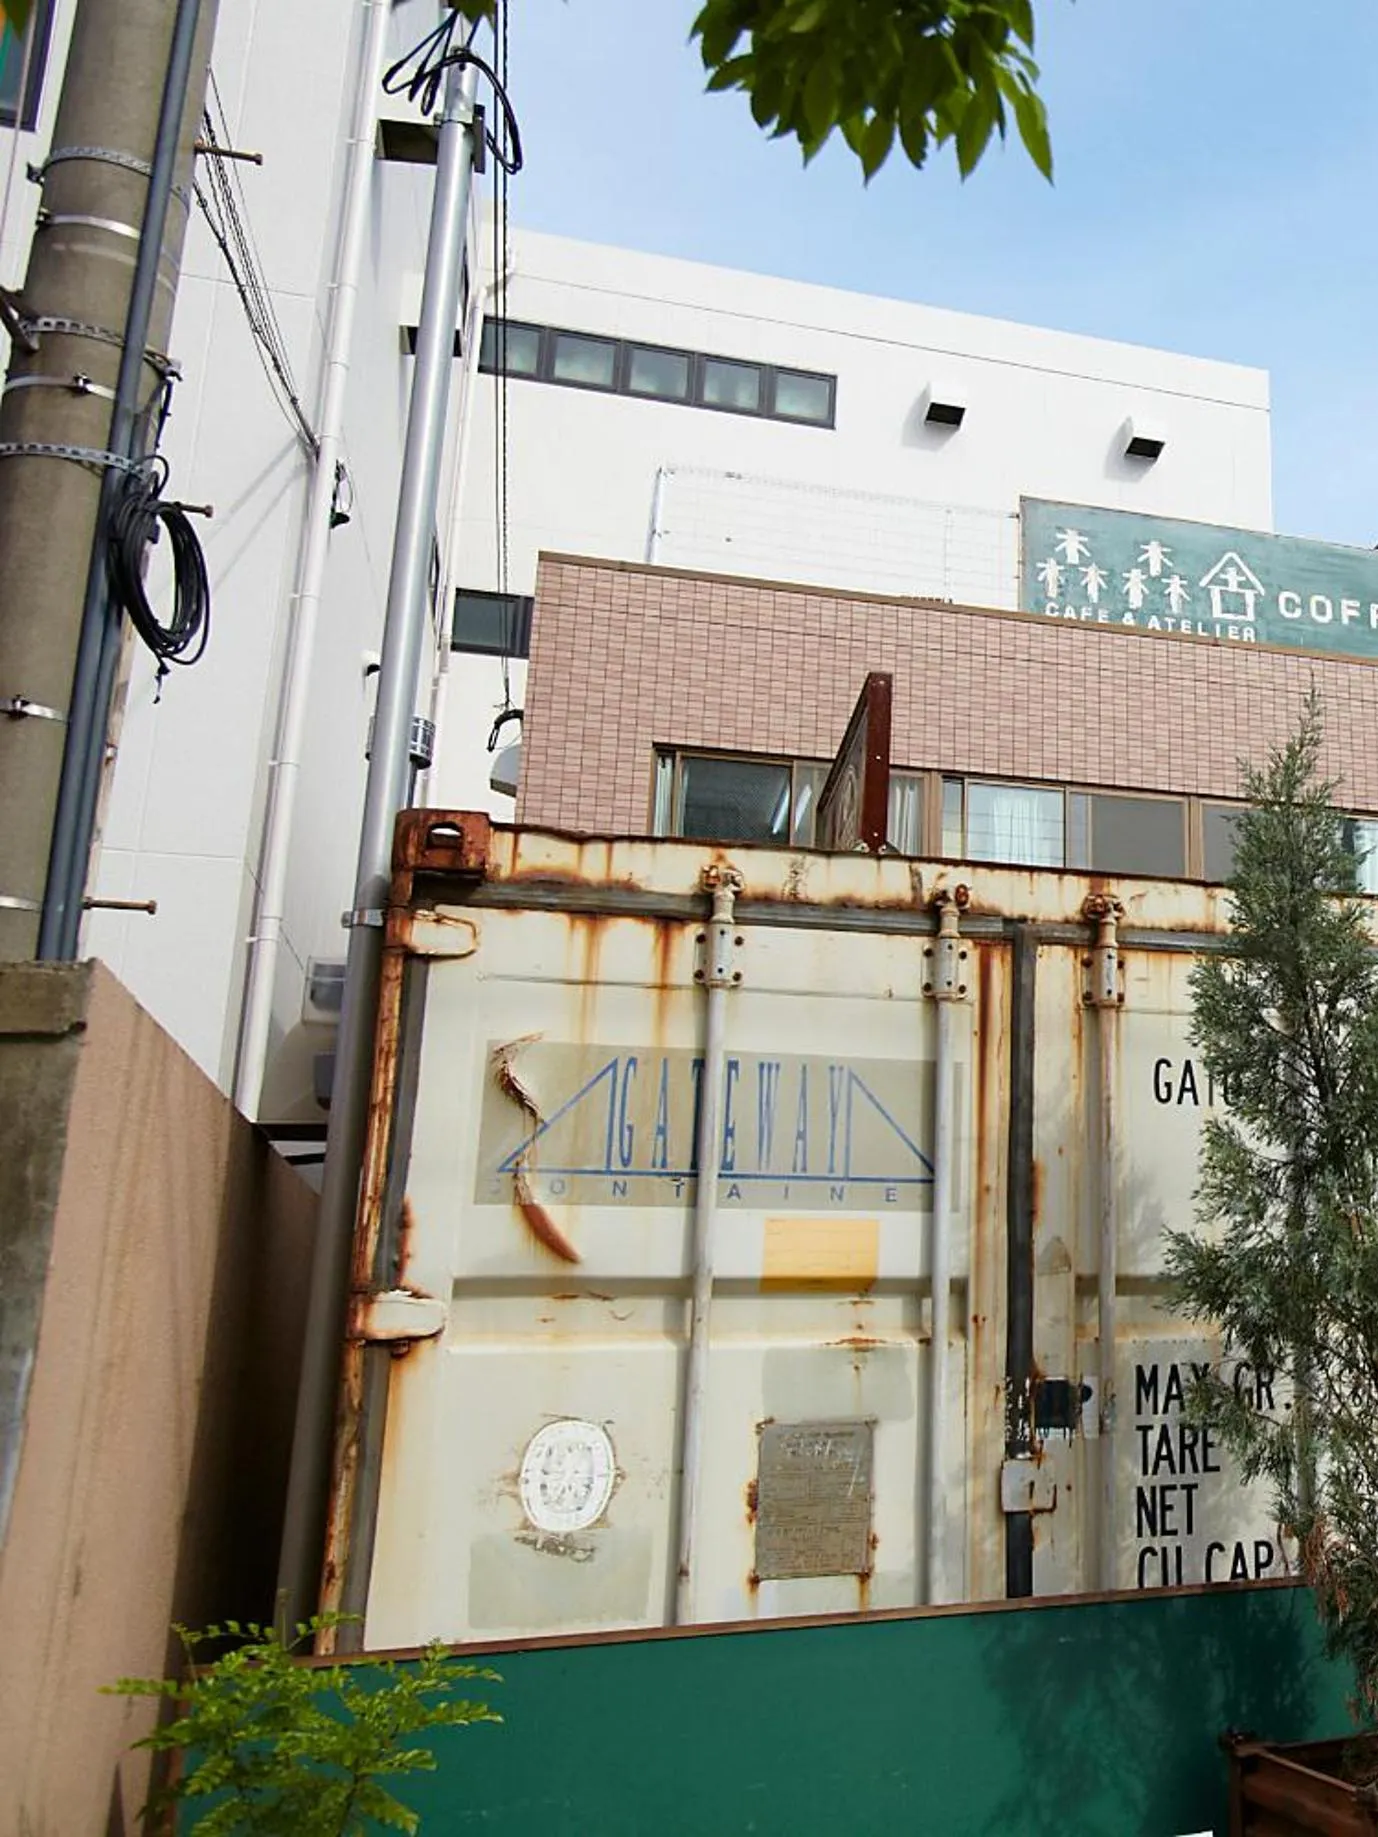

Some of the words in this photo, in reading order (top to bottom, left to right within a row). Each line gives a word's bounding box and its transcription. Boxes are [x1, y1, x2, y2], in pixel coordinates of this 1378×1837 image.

[1045, 602, 1109, 624] CAFE
[1122, 611, 1135, 626] &
[1148, 615, 1255, 643] ATELIER
[619, 1056, 844, 1173] GATEWAY
[489, 1178, 898, 1202] ONTAINE
[1135, 1424, 1220, 1476] TARE
[1136, 1484, 1199, 1538] NET
[1205, 1541, 1275, 1583] CAP
